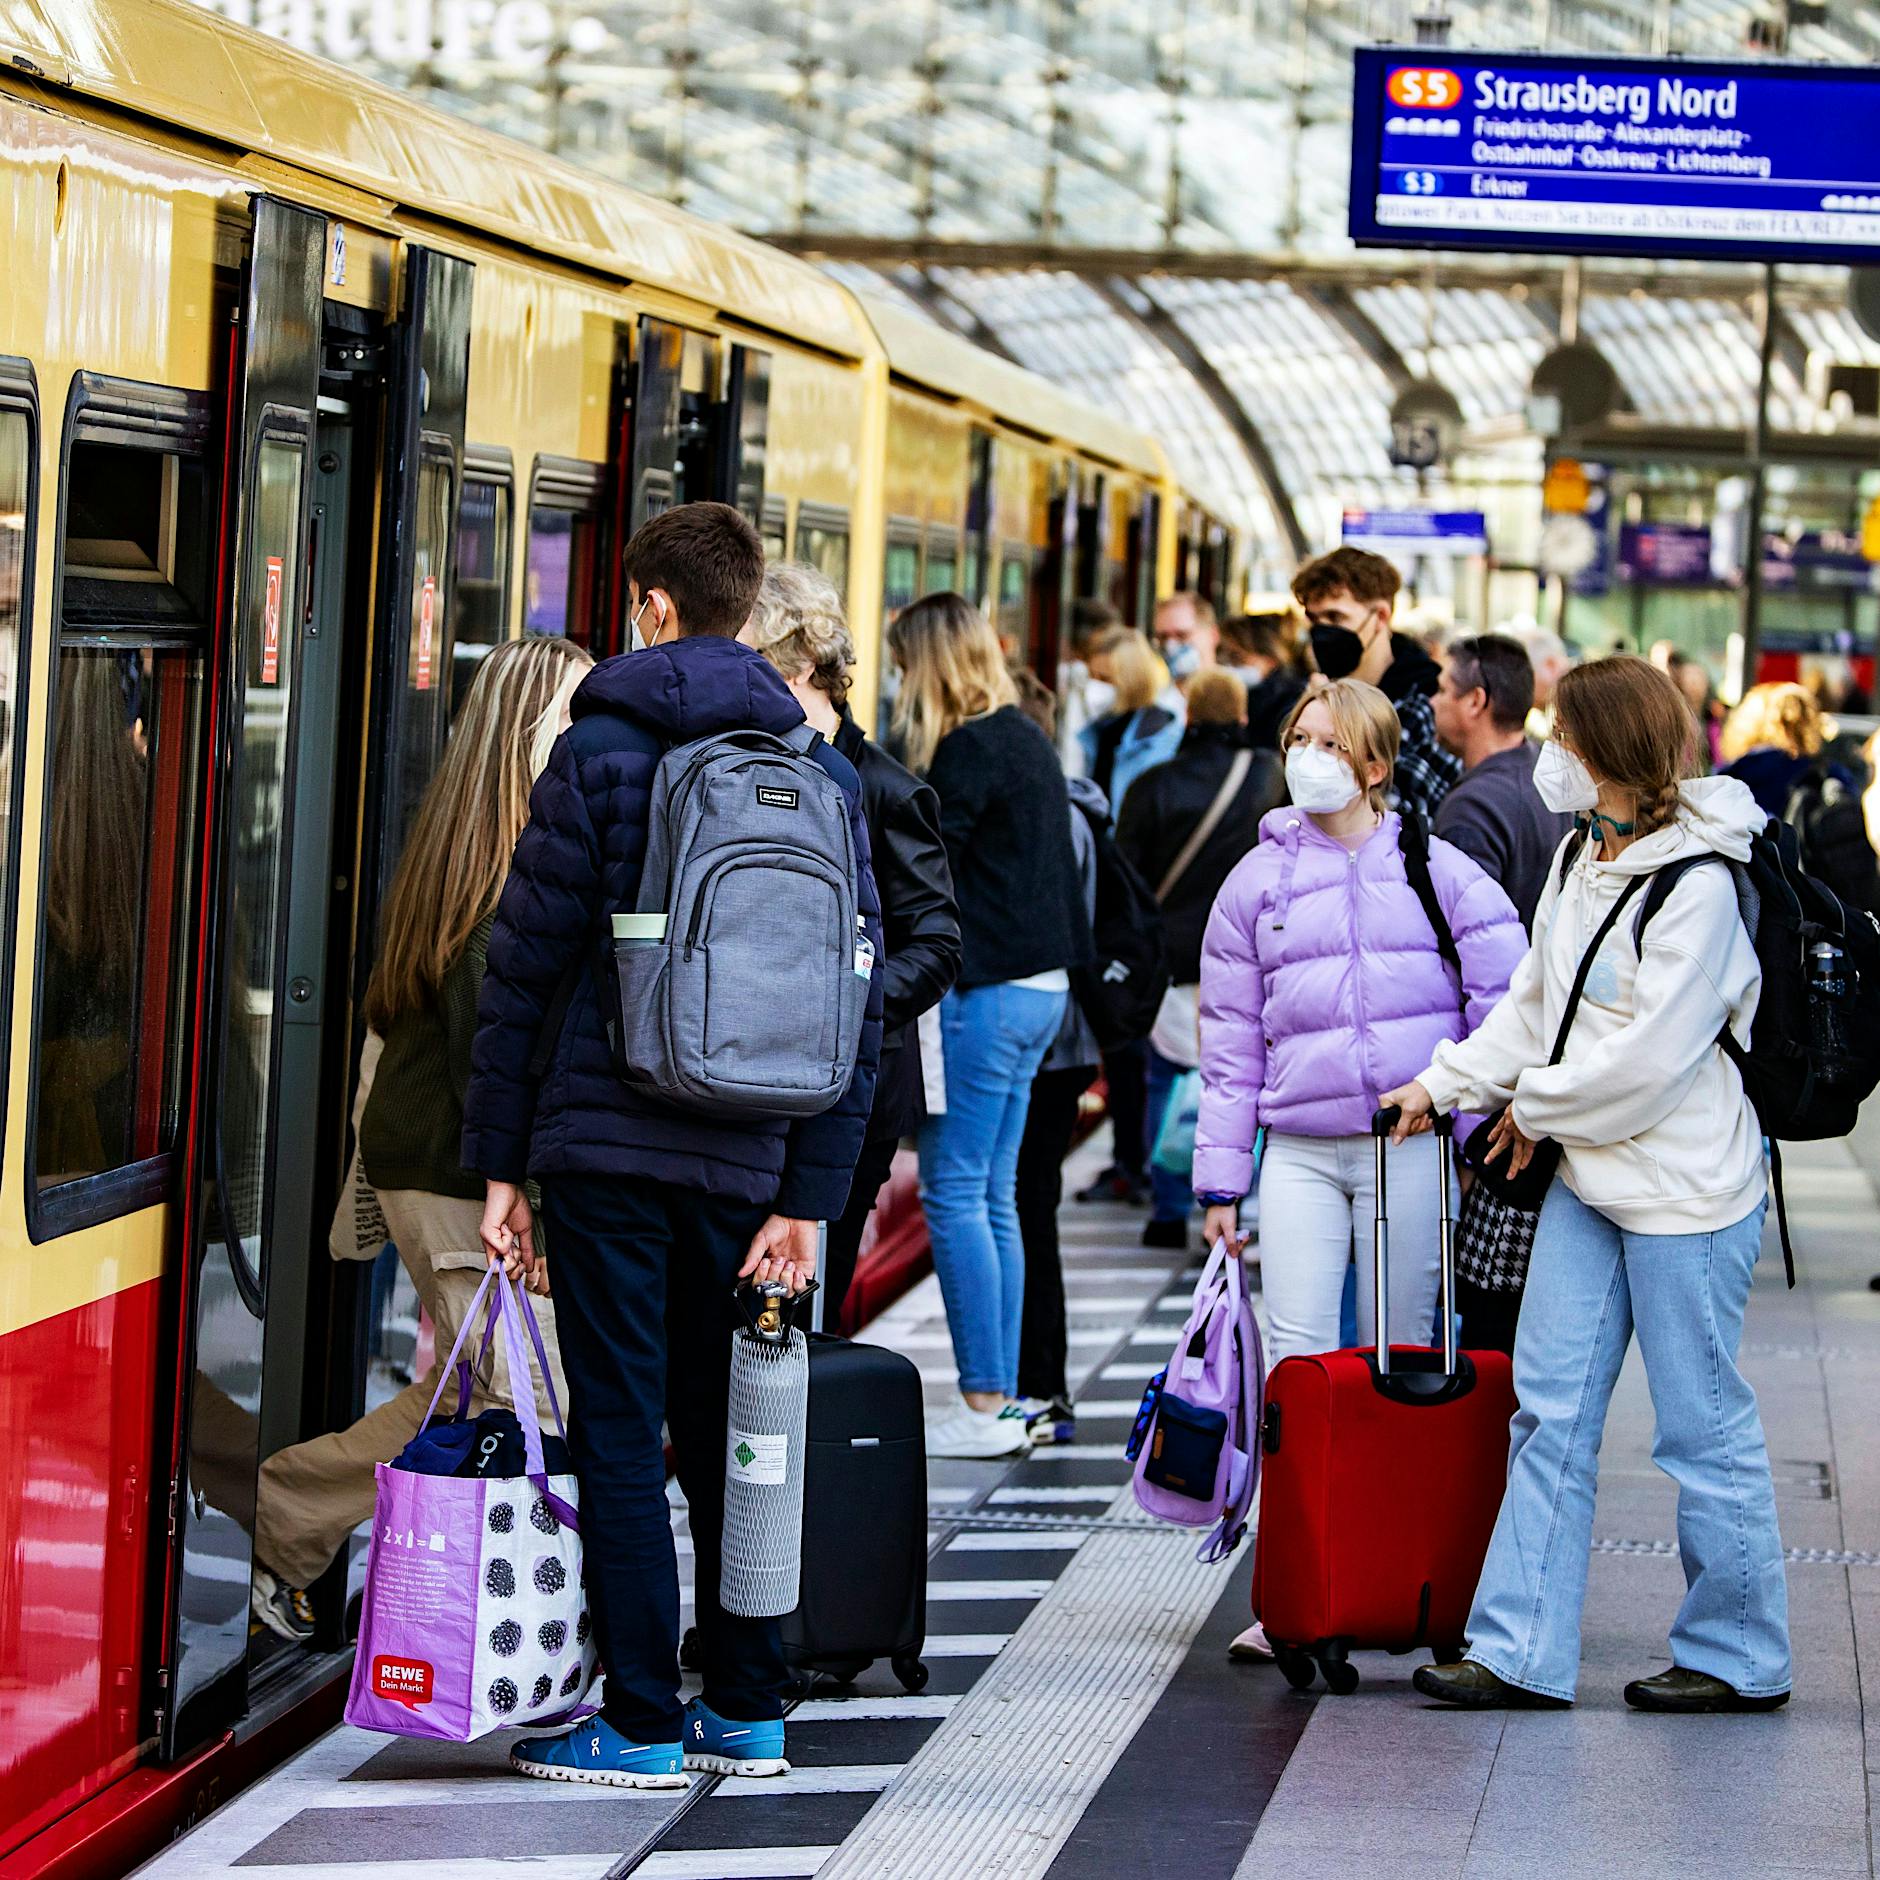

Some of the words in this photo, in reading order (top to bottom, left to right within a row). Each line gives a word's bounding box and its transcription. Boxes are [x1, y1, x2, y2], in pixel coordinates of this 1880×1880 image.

[1474, 70, 1650, 124] Strausberg
[1657, 78, 1737, 119] Nord
[1471, 173, 1528, 197] Erkner
[383, 1526, 392, 1544] 2
[381, 1664, 424, 1682] REWE
[380, 1679, 398, 1690] Dein
[399, 1682, 424, 1693] Markt
